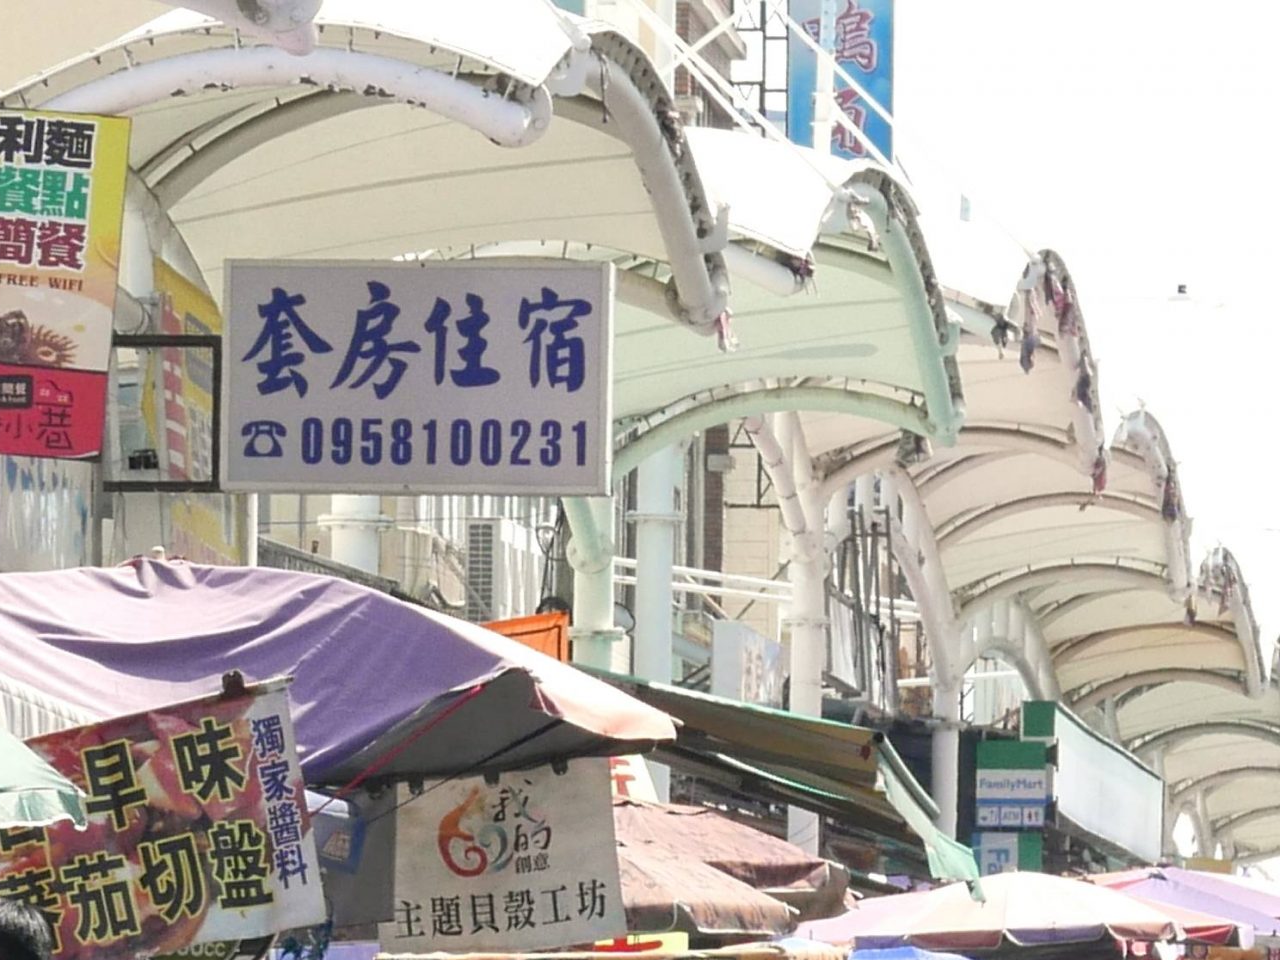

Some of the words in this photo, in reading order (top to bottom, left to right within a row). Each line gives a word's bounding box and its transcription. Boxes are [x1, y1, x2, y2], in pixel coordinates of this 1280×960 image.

[48, 276, 84, 292] WIFI
[241, 281, 593, 399] 套房住宿
[301, 417, 587, 467] 0958100231
[251, 713, 308, 889] 獨家醬料
[979, 777, 1043, 792] FamilyMart
[394, 878, 606, 939] 主題貝殼工坊
